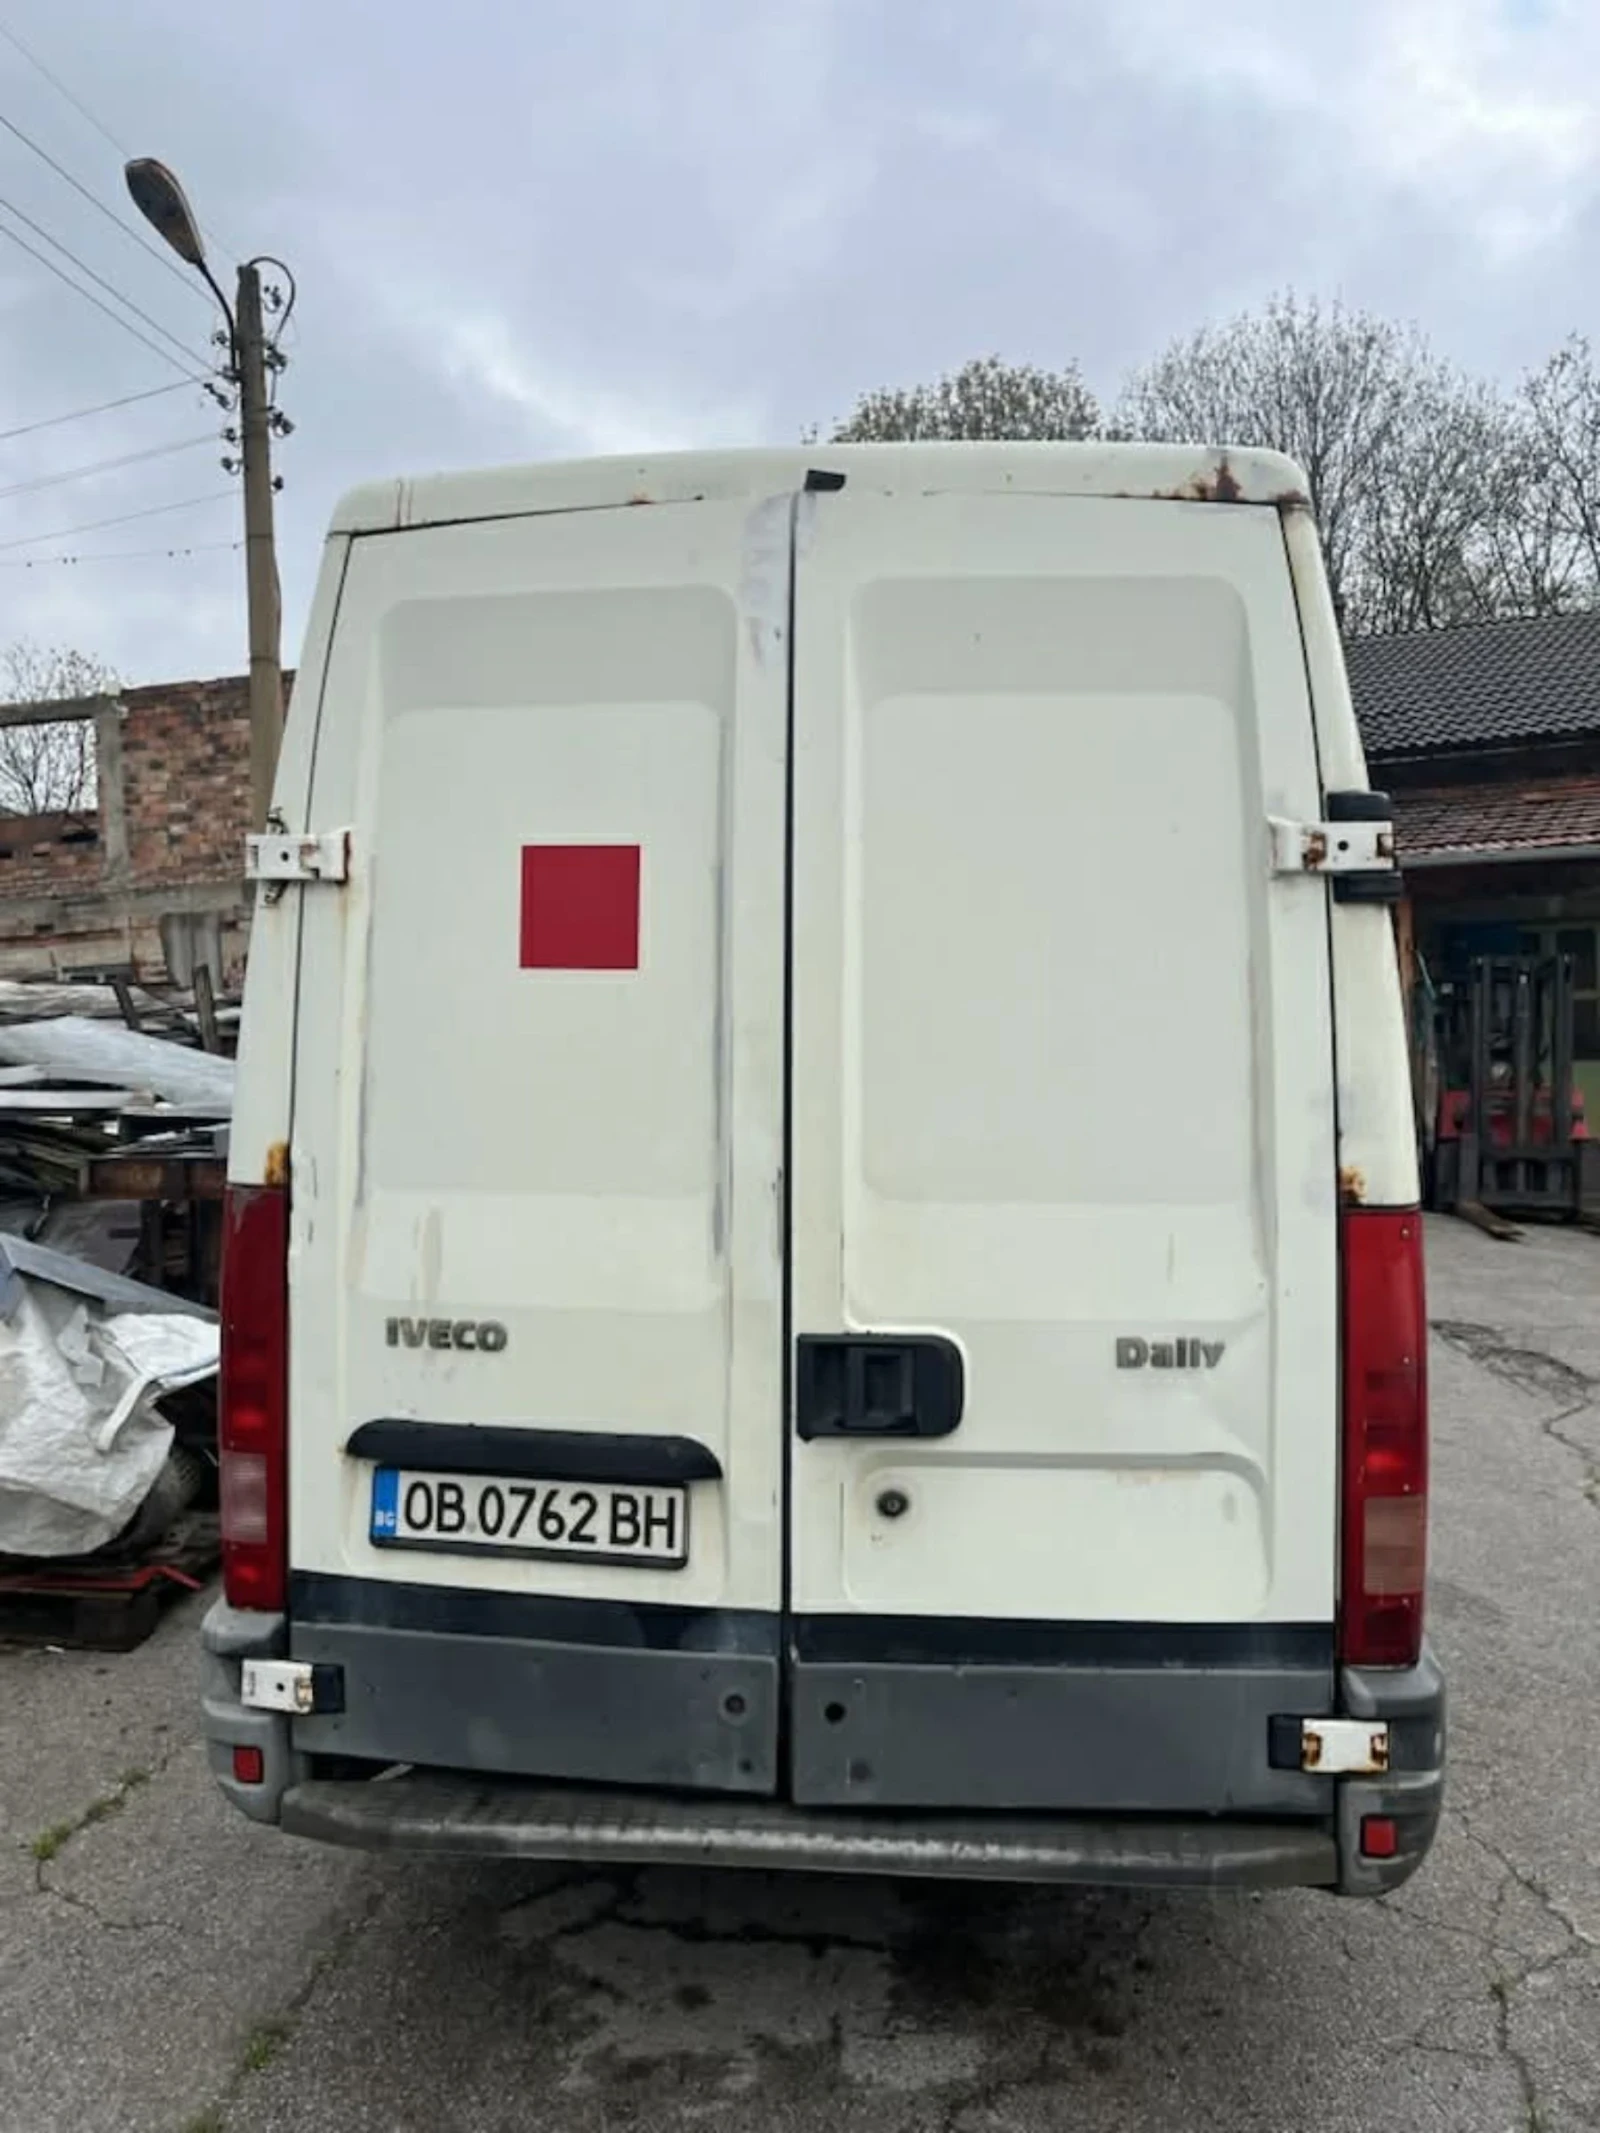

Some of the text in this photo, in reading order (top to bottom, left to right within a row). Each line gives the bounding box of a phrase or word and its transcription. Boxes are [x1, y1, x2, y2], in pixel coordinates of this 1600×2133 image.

[385, 1317, 508, 1352] IVECO
[404, 1481, 676, 1549] OB 0762 BH
